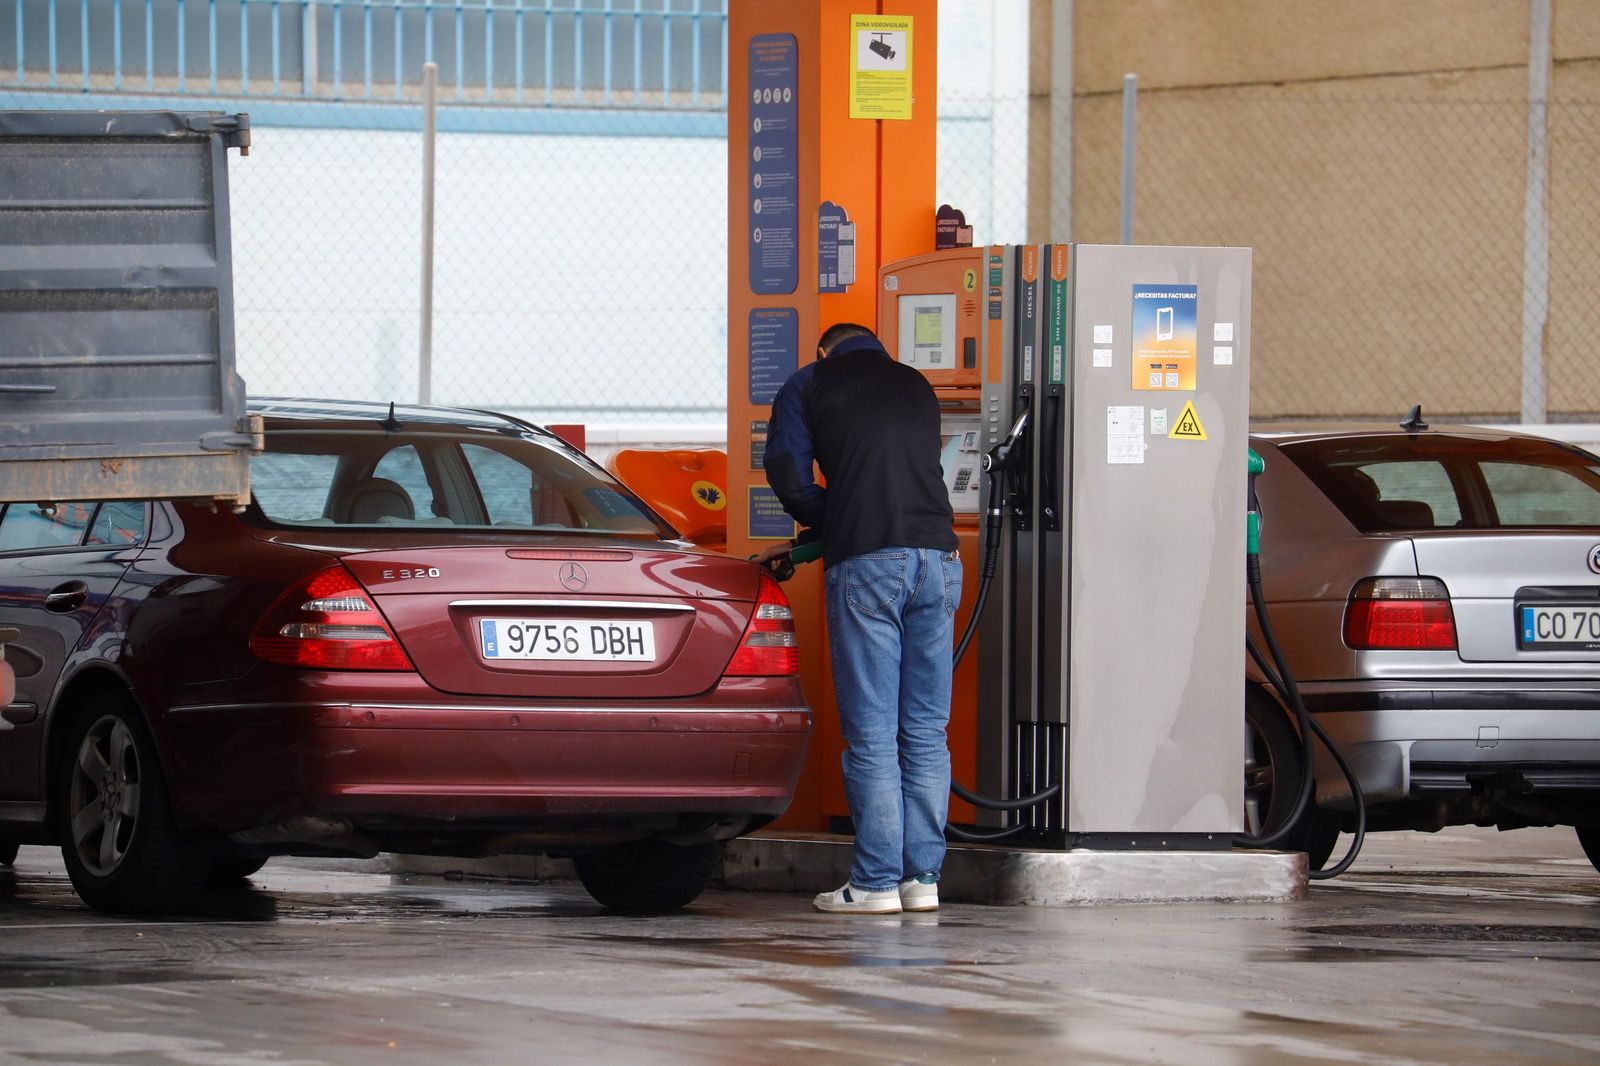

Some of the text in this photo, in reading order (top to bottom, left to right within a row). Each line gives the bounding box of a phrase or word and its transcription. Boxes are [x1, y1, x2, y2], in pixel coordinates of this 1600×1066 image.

[967, 272, 974, 289] 2
[1182, 422, 1193, 432] EX
[507, 624, 645, 656] 9756 DBH
[1525, 629, 1532, 638] E
